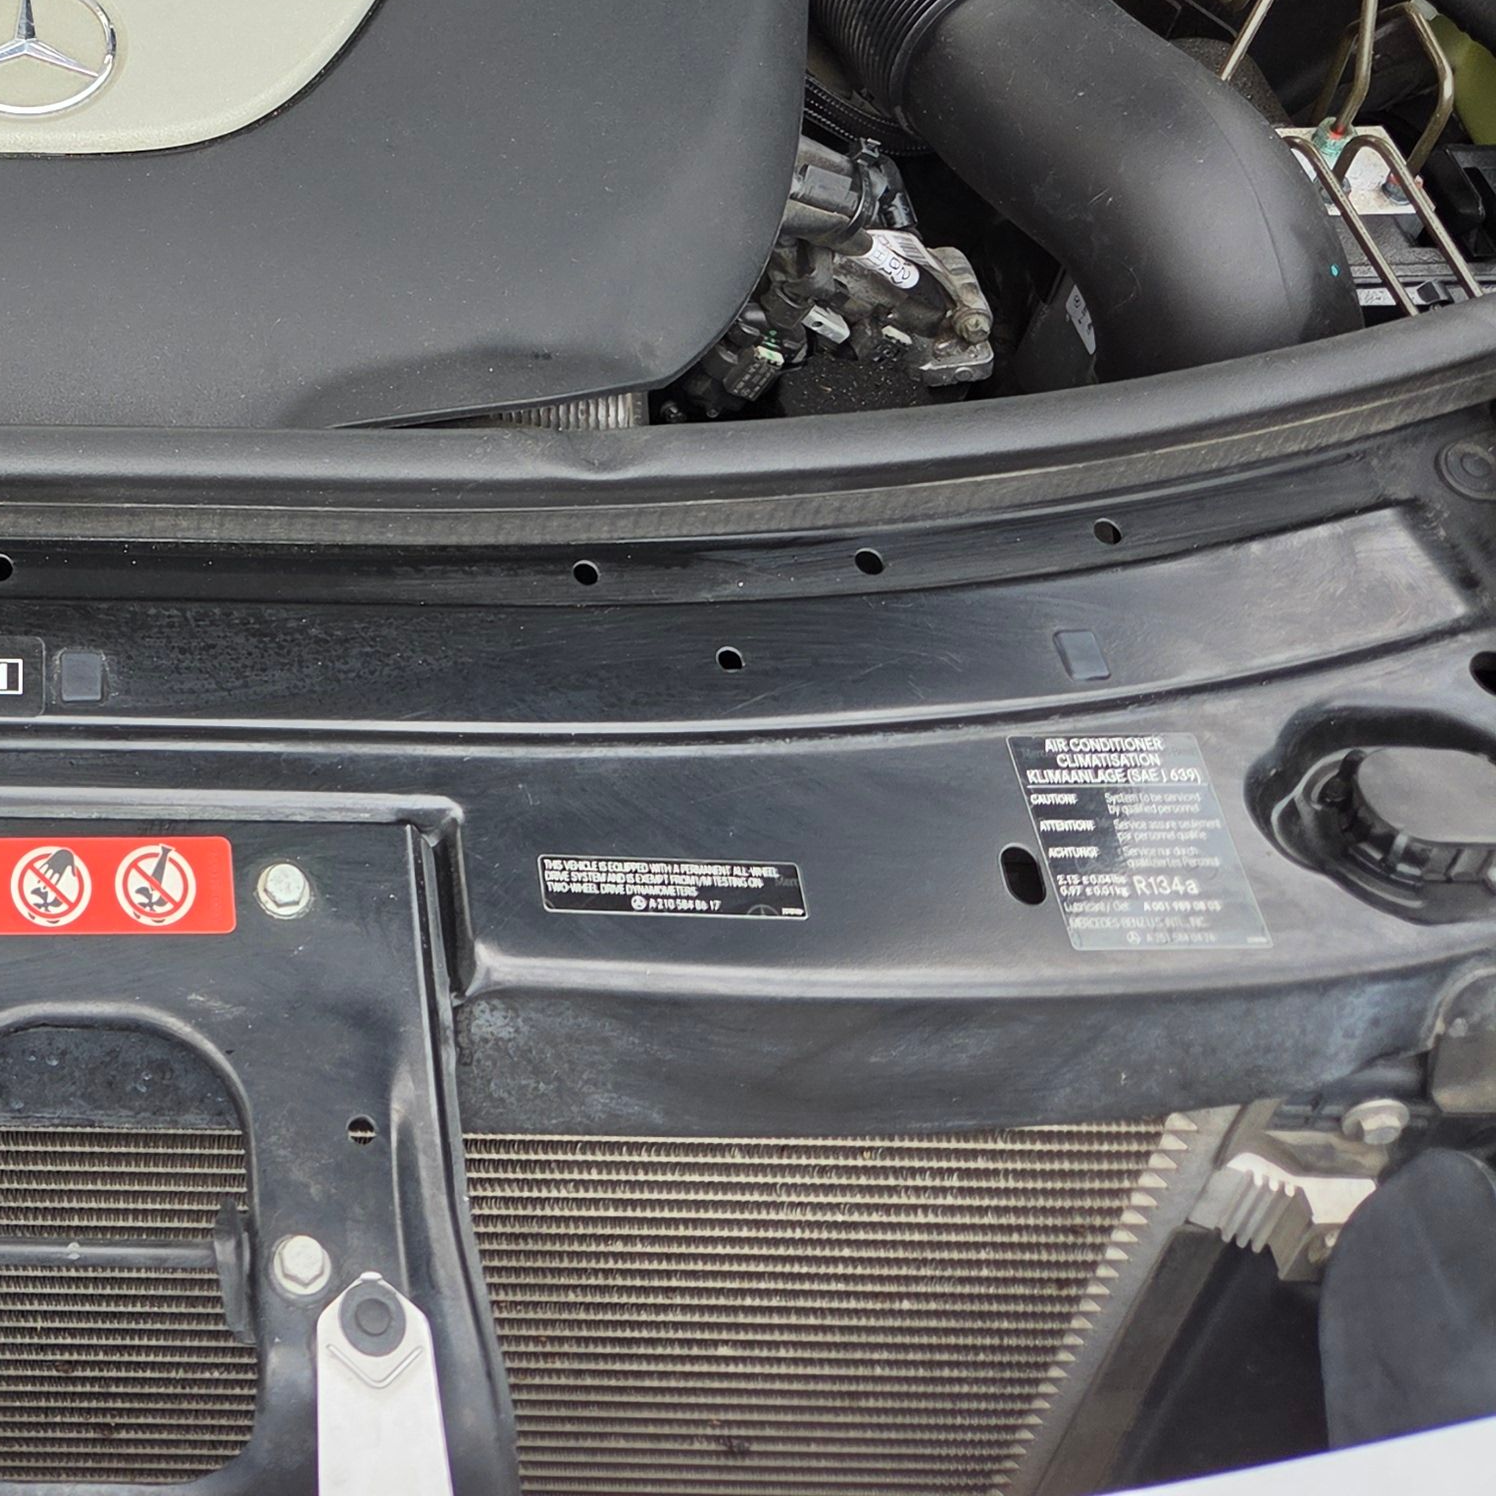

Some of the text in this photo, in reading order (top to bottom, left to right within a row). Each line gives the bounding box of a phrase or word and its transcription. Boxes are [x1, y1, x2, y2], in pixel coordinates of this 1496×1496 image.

[1044, 738, 1067, 753] AIR
[1069, 737, 1165, 752] CONDITIONER
[1056, 753, 1161, 768] CLIMATISATION
[1026, 769, 1126, 784] KLIMAANLAGE
[1127, 769, 1160, 784] (SAE
[1170, 767, 1202, 785] 639)
[543, 859, 563, 870] THIS
[564, 860, 598, 871] VEHICLE
[608, 861, 649, 873] EQUIPPED
[649, 862, 672, 874] WITH
[680, 864, 731, 876] PERMANENT
[545, 871, 570, 882] DRIVE
[571, 871, 606, 883] SYSTEM
[607, 872, 625, 883] AND
[635, 873, 668, 885] EXEMPT
[1132, 875, 1200, 896] R134a
[600, 883, 625, 895] DRIVE
